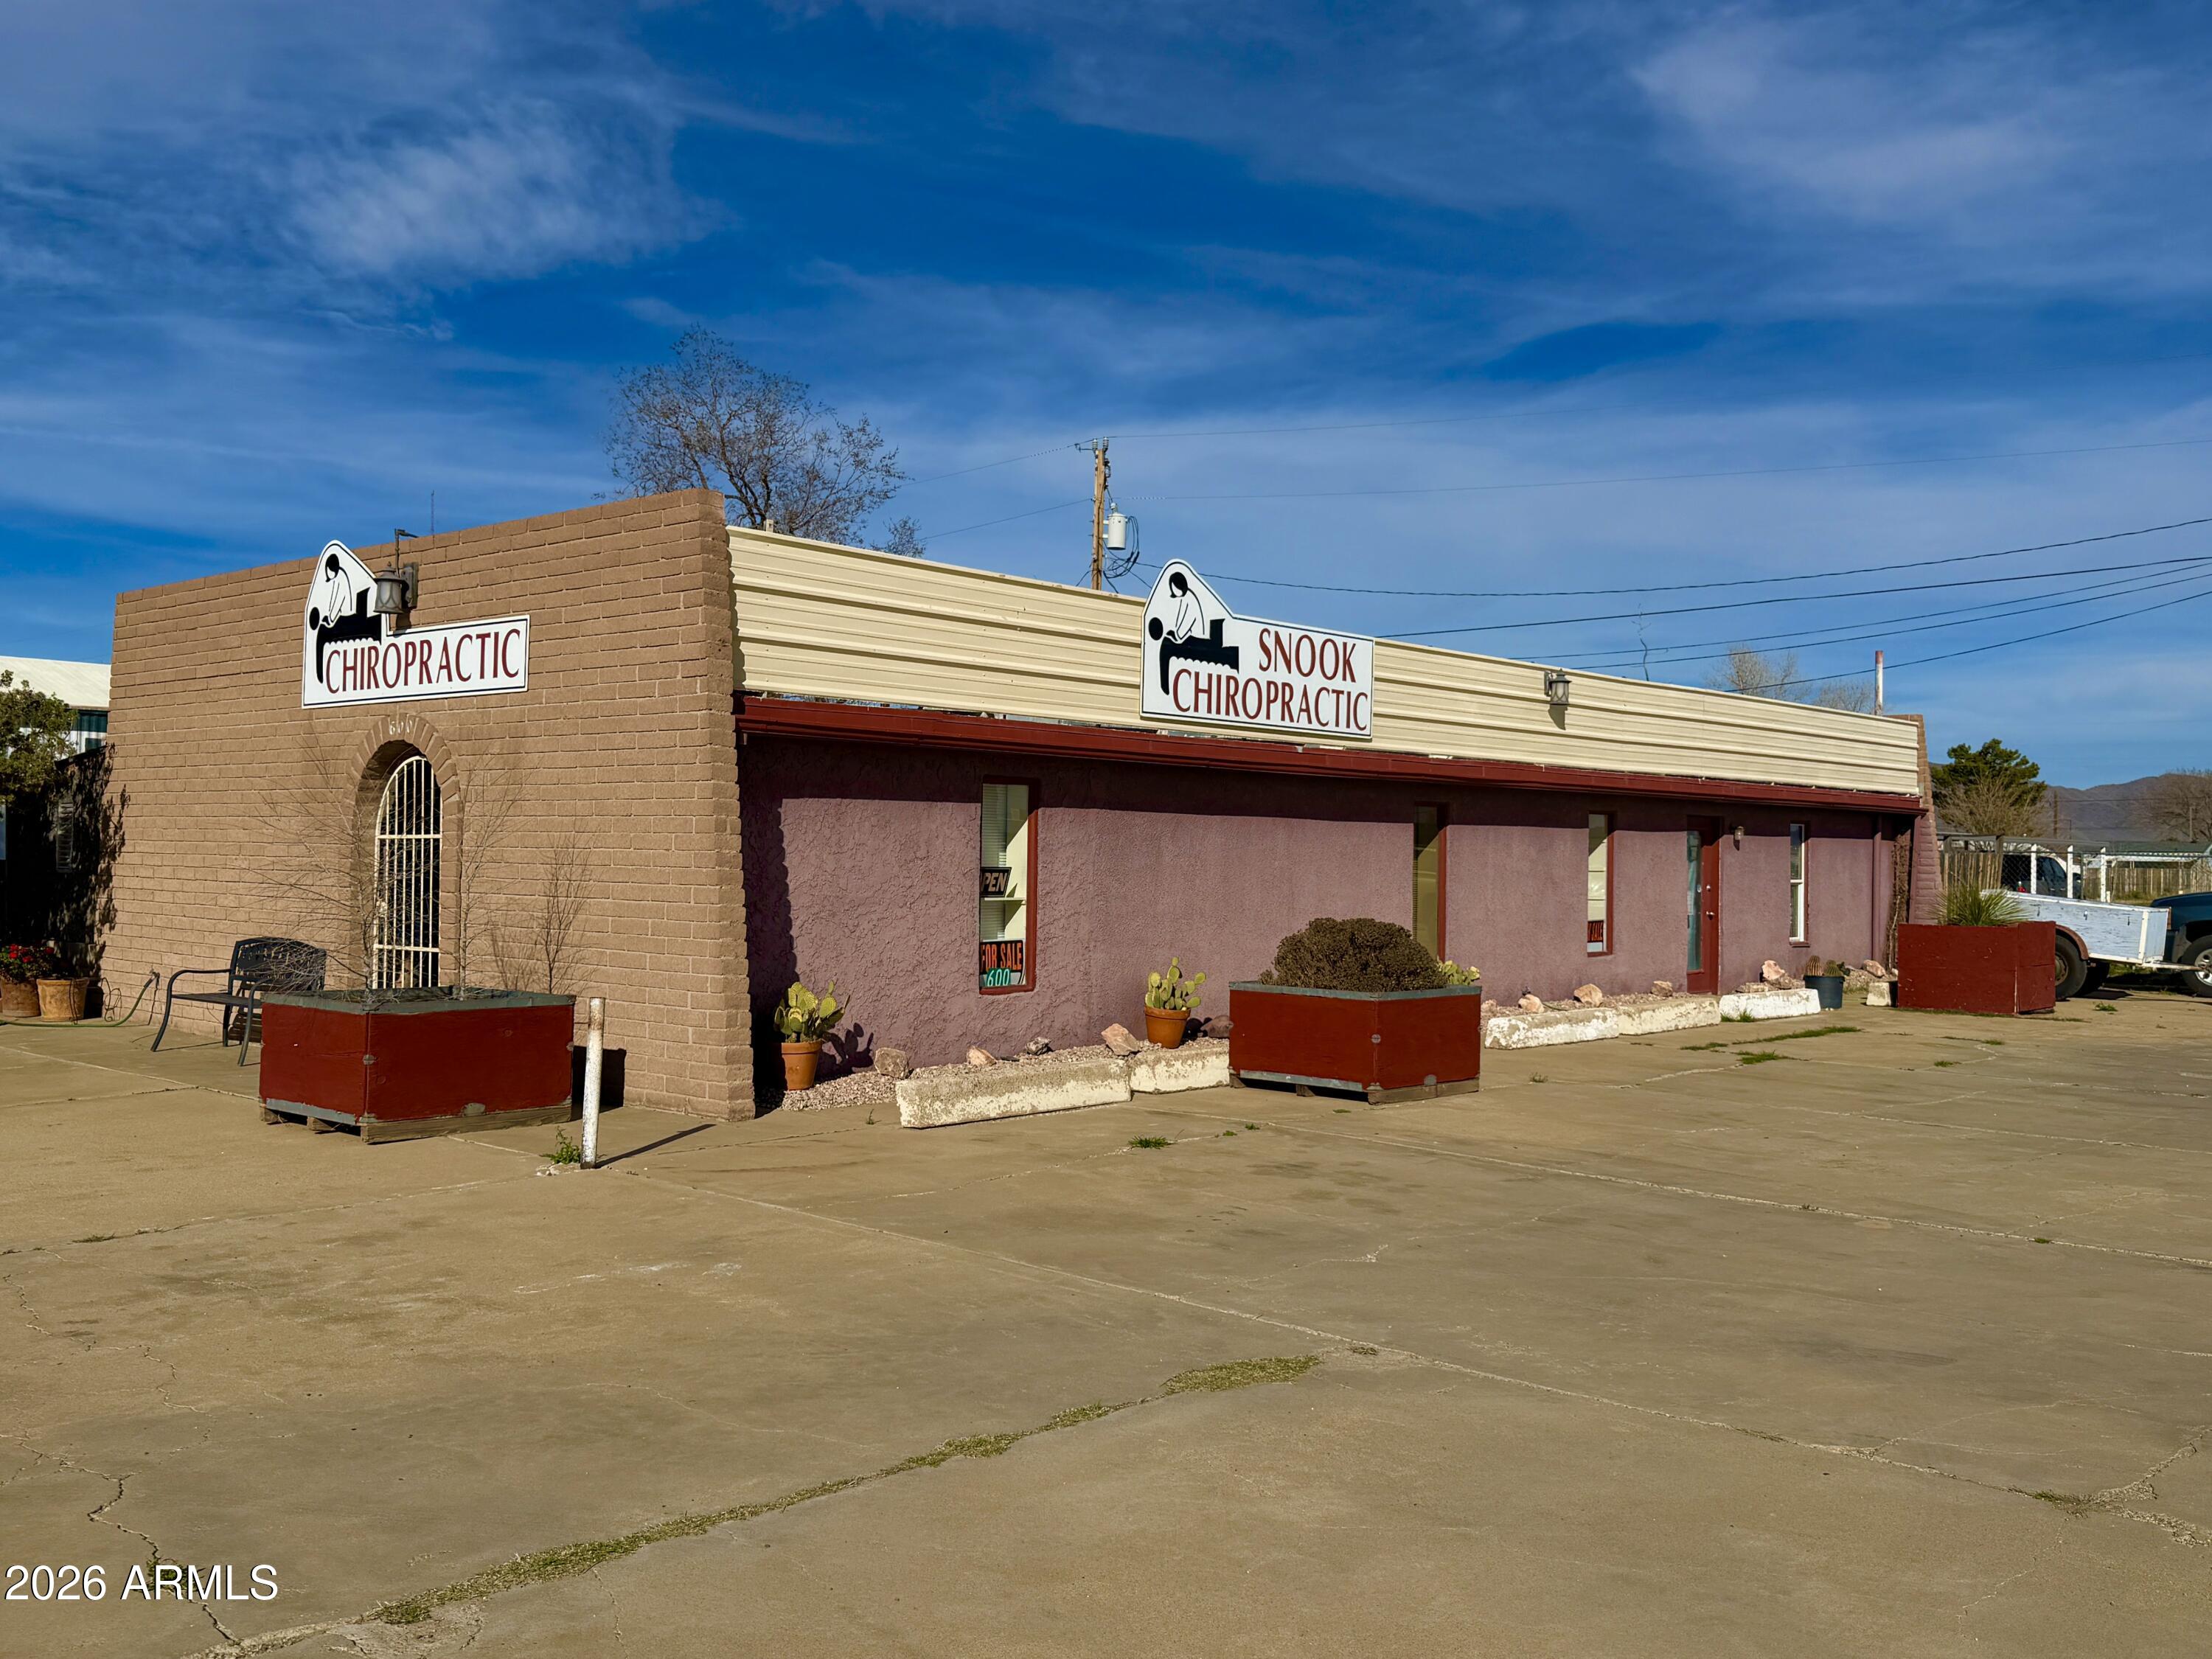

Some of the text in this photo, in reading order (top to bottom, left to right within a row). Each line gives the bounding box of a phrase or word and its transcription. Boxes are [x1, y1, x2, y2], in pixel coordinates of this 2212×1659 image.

[326, 628, 521, 694] CHIROPRACTIC
[1259, 627, 1356, 683] SNOOK
[1172, 668, 1368, 731] CHIROPRACTIC
[981, 872, 1008, 892] PEN
[1000, 942, 1022, 970] SALE
[987, 968, 1009, 987] 600
